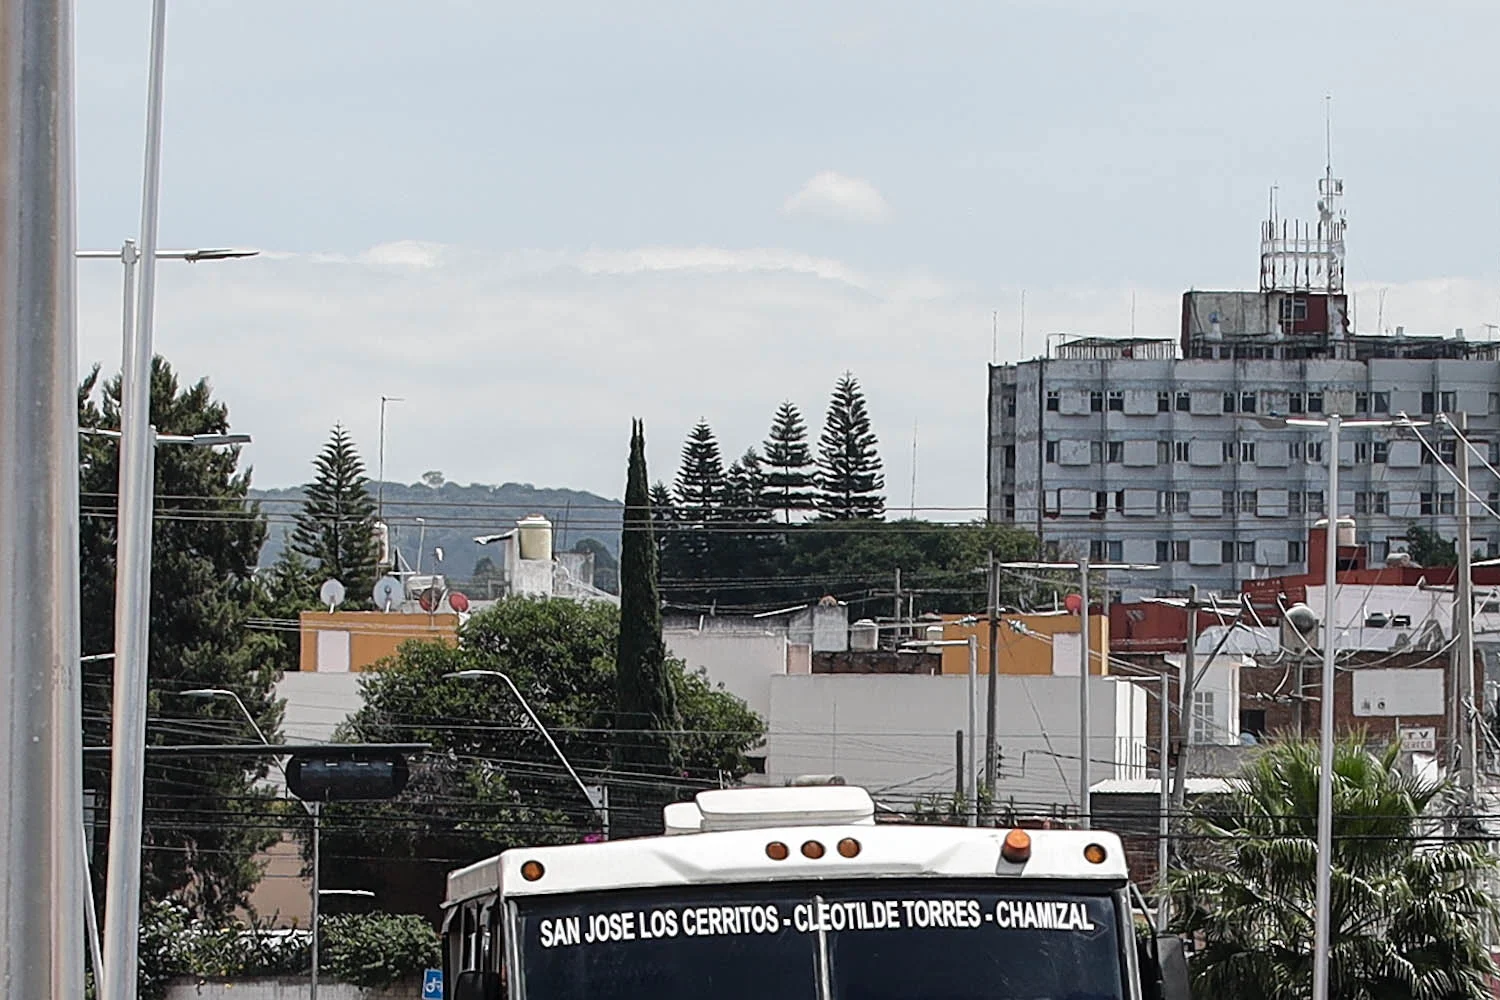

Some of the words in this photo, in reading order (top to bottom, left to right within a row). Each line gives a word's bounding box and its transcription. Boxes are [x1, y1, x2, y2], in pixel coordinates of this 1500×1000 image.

[540, 917, 580, 947] SAN
[585, 912, 635, 943] JOSE
[639, 910, 678, 938] LOS
[682, 905, 779, 936] CERRITOS
[794, 901, 900, 932] CLEOTILDE
[902, 900, 981, 927] TORRES
[996, 901, 1095, 930] CHAMIZAL
